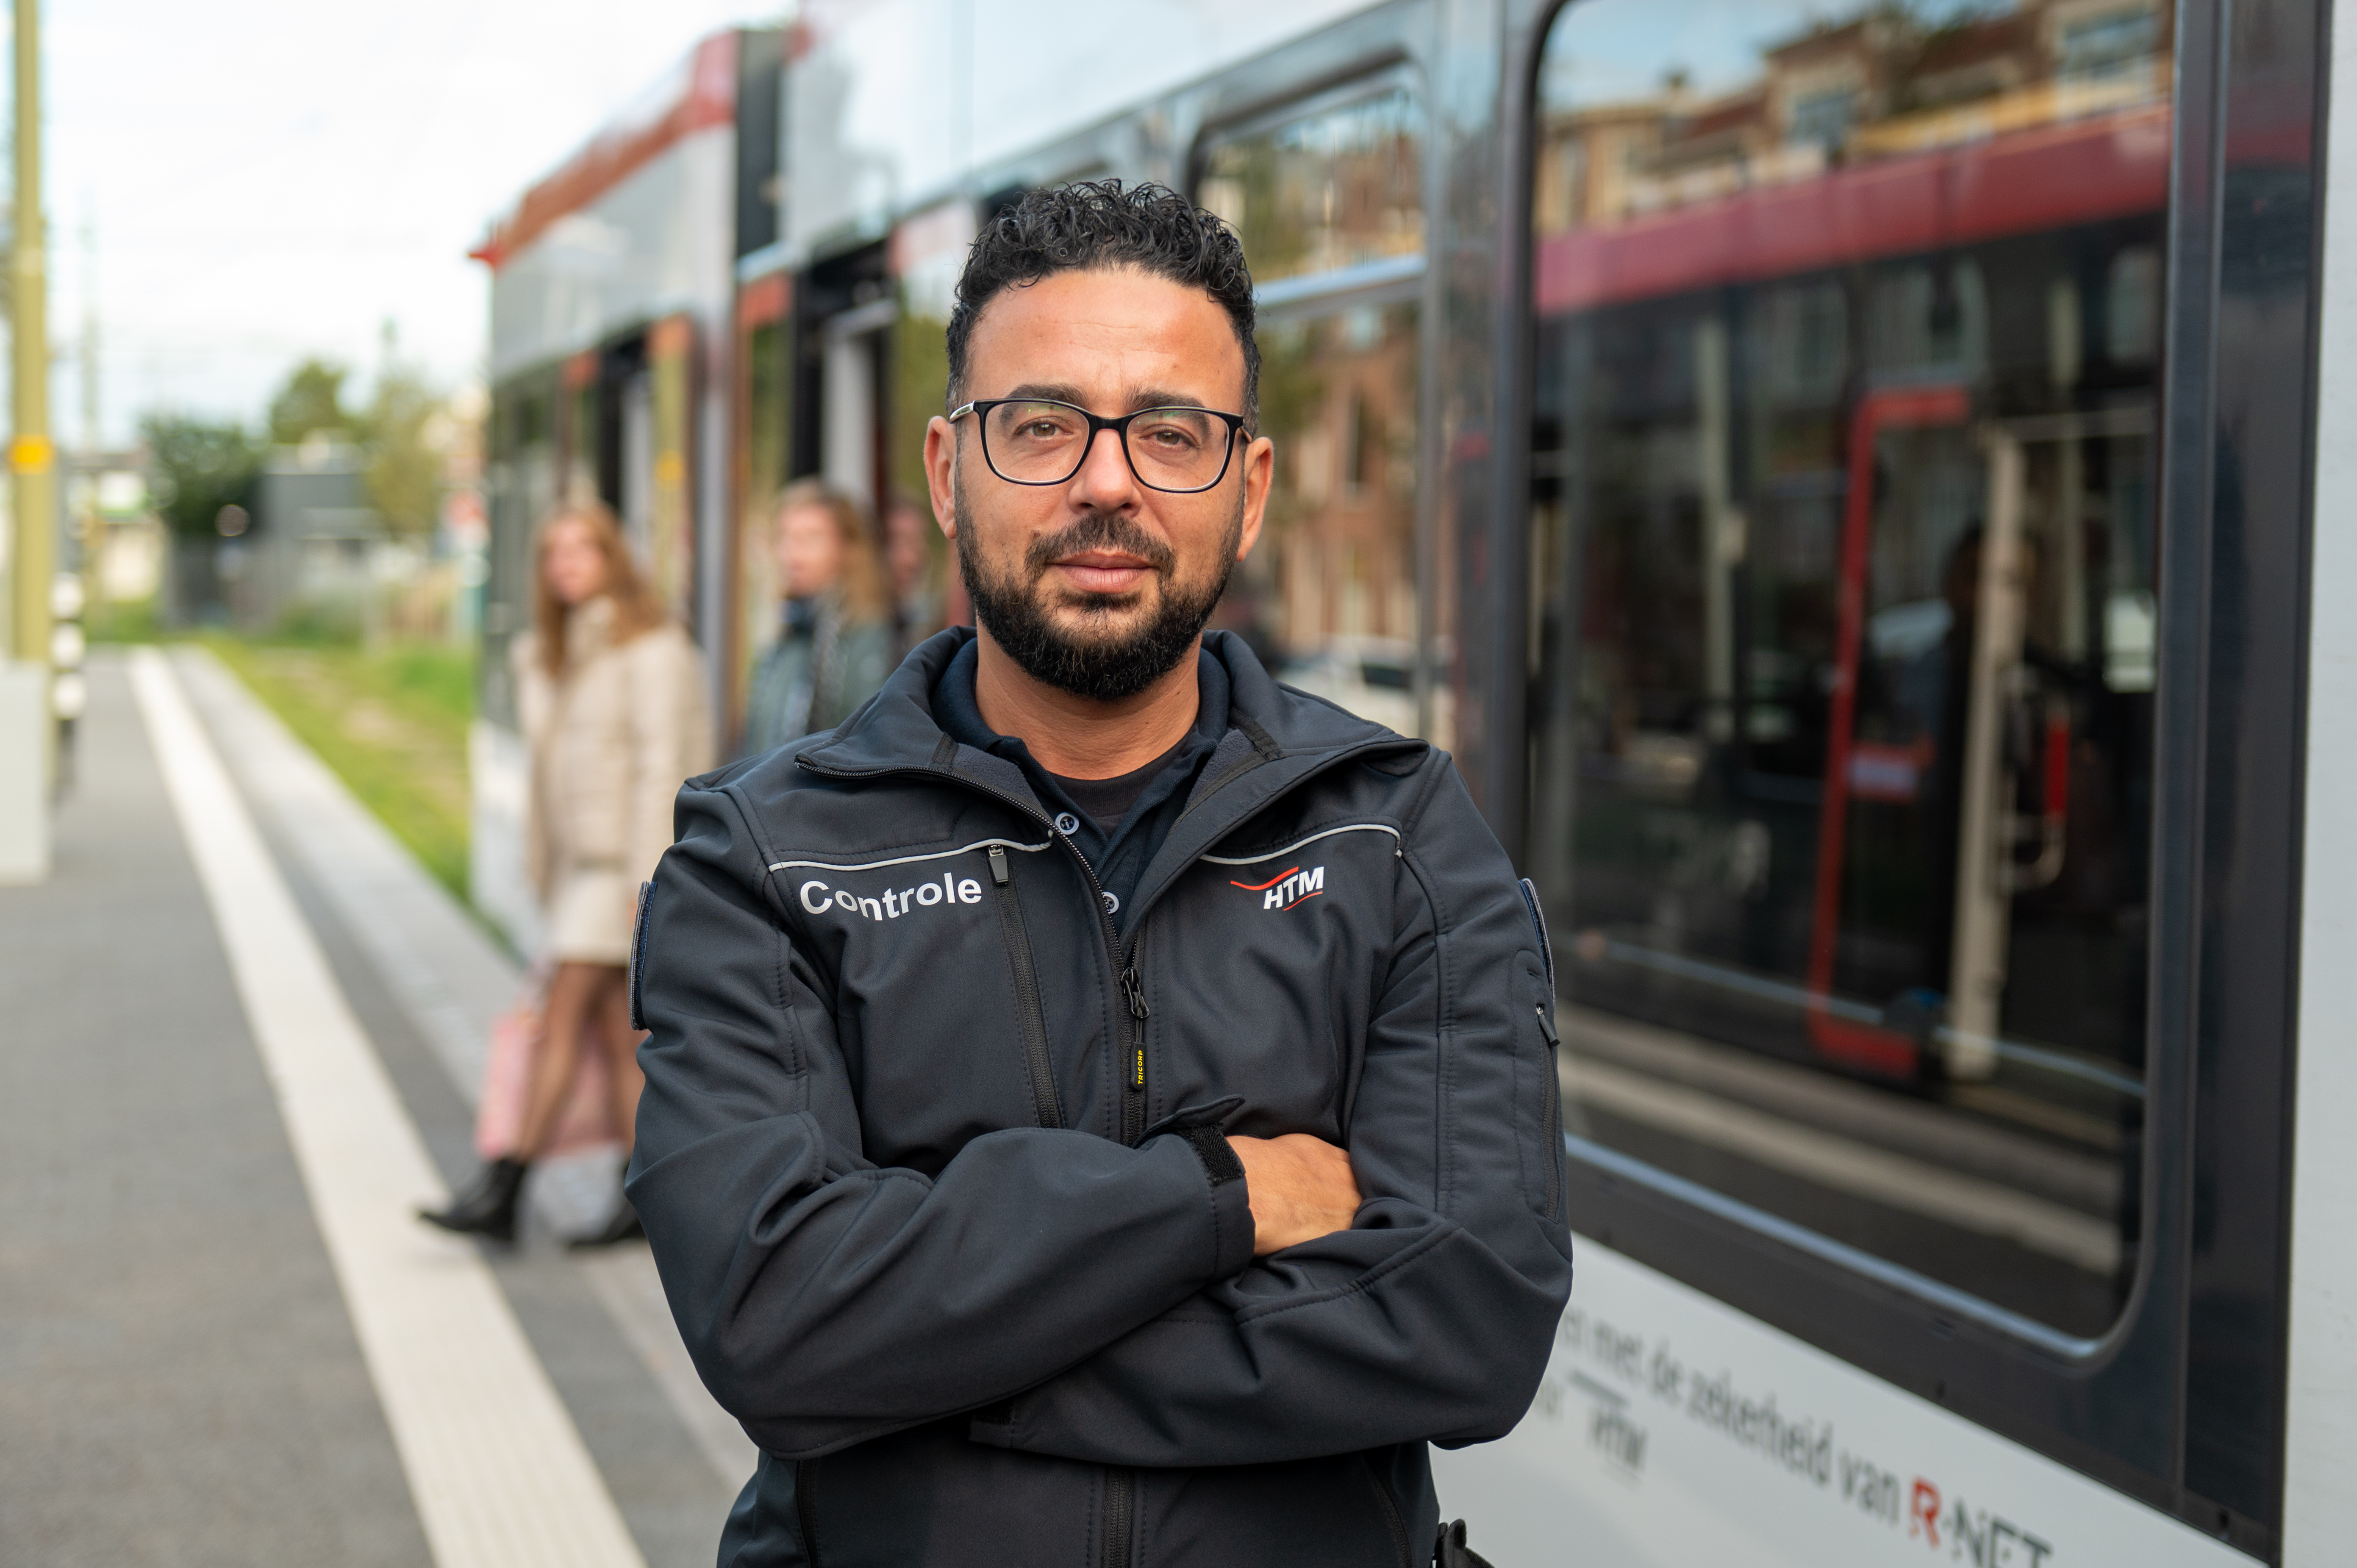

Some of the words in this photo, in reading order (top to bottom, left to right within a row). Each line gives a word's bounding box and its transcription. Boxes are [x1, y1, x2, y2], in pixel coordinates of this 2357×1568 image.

[800, 872, 982, 921] Controle
[1263, 866, 1324, 910] HTM
[1649, 1335, 1685, 1407] de
[1687, 1368, 1835, 1486] zekerheid
[1837, 1448, 1901, 1527] van
